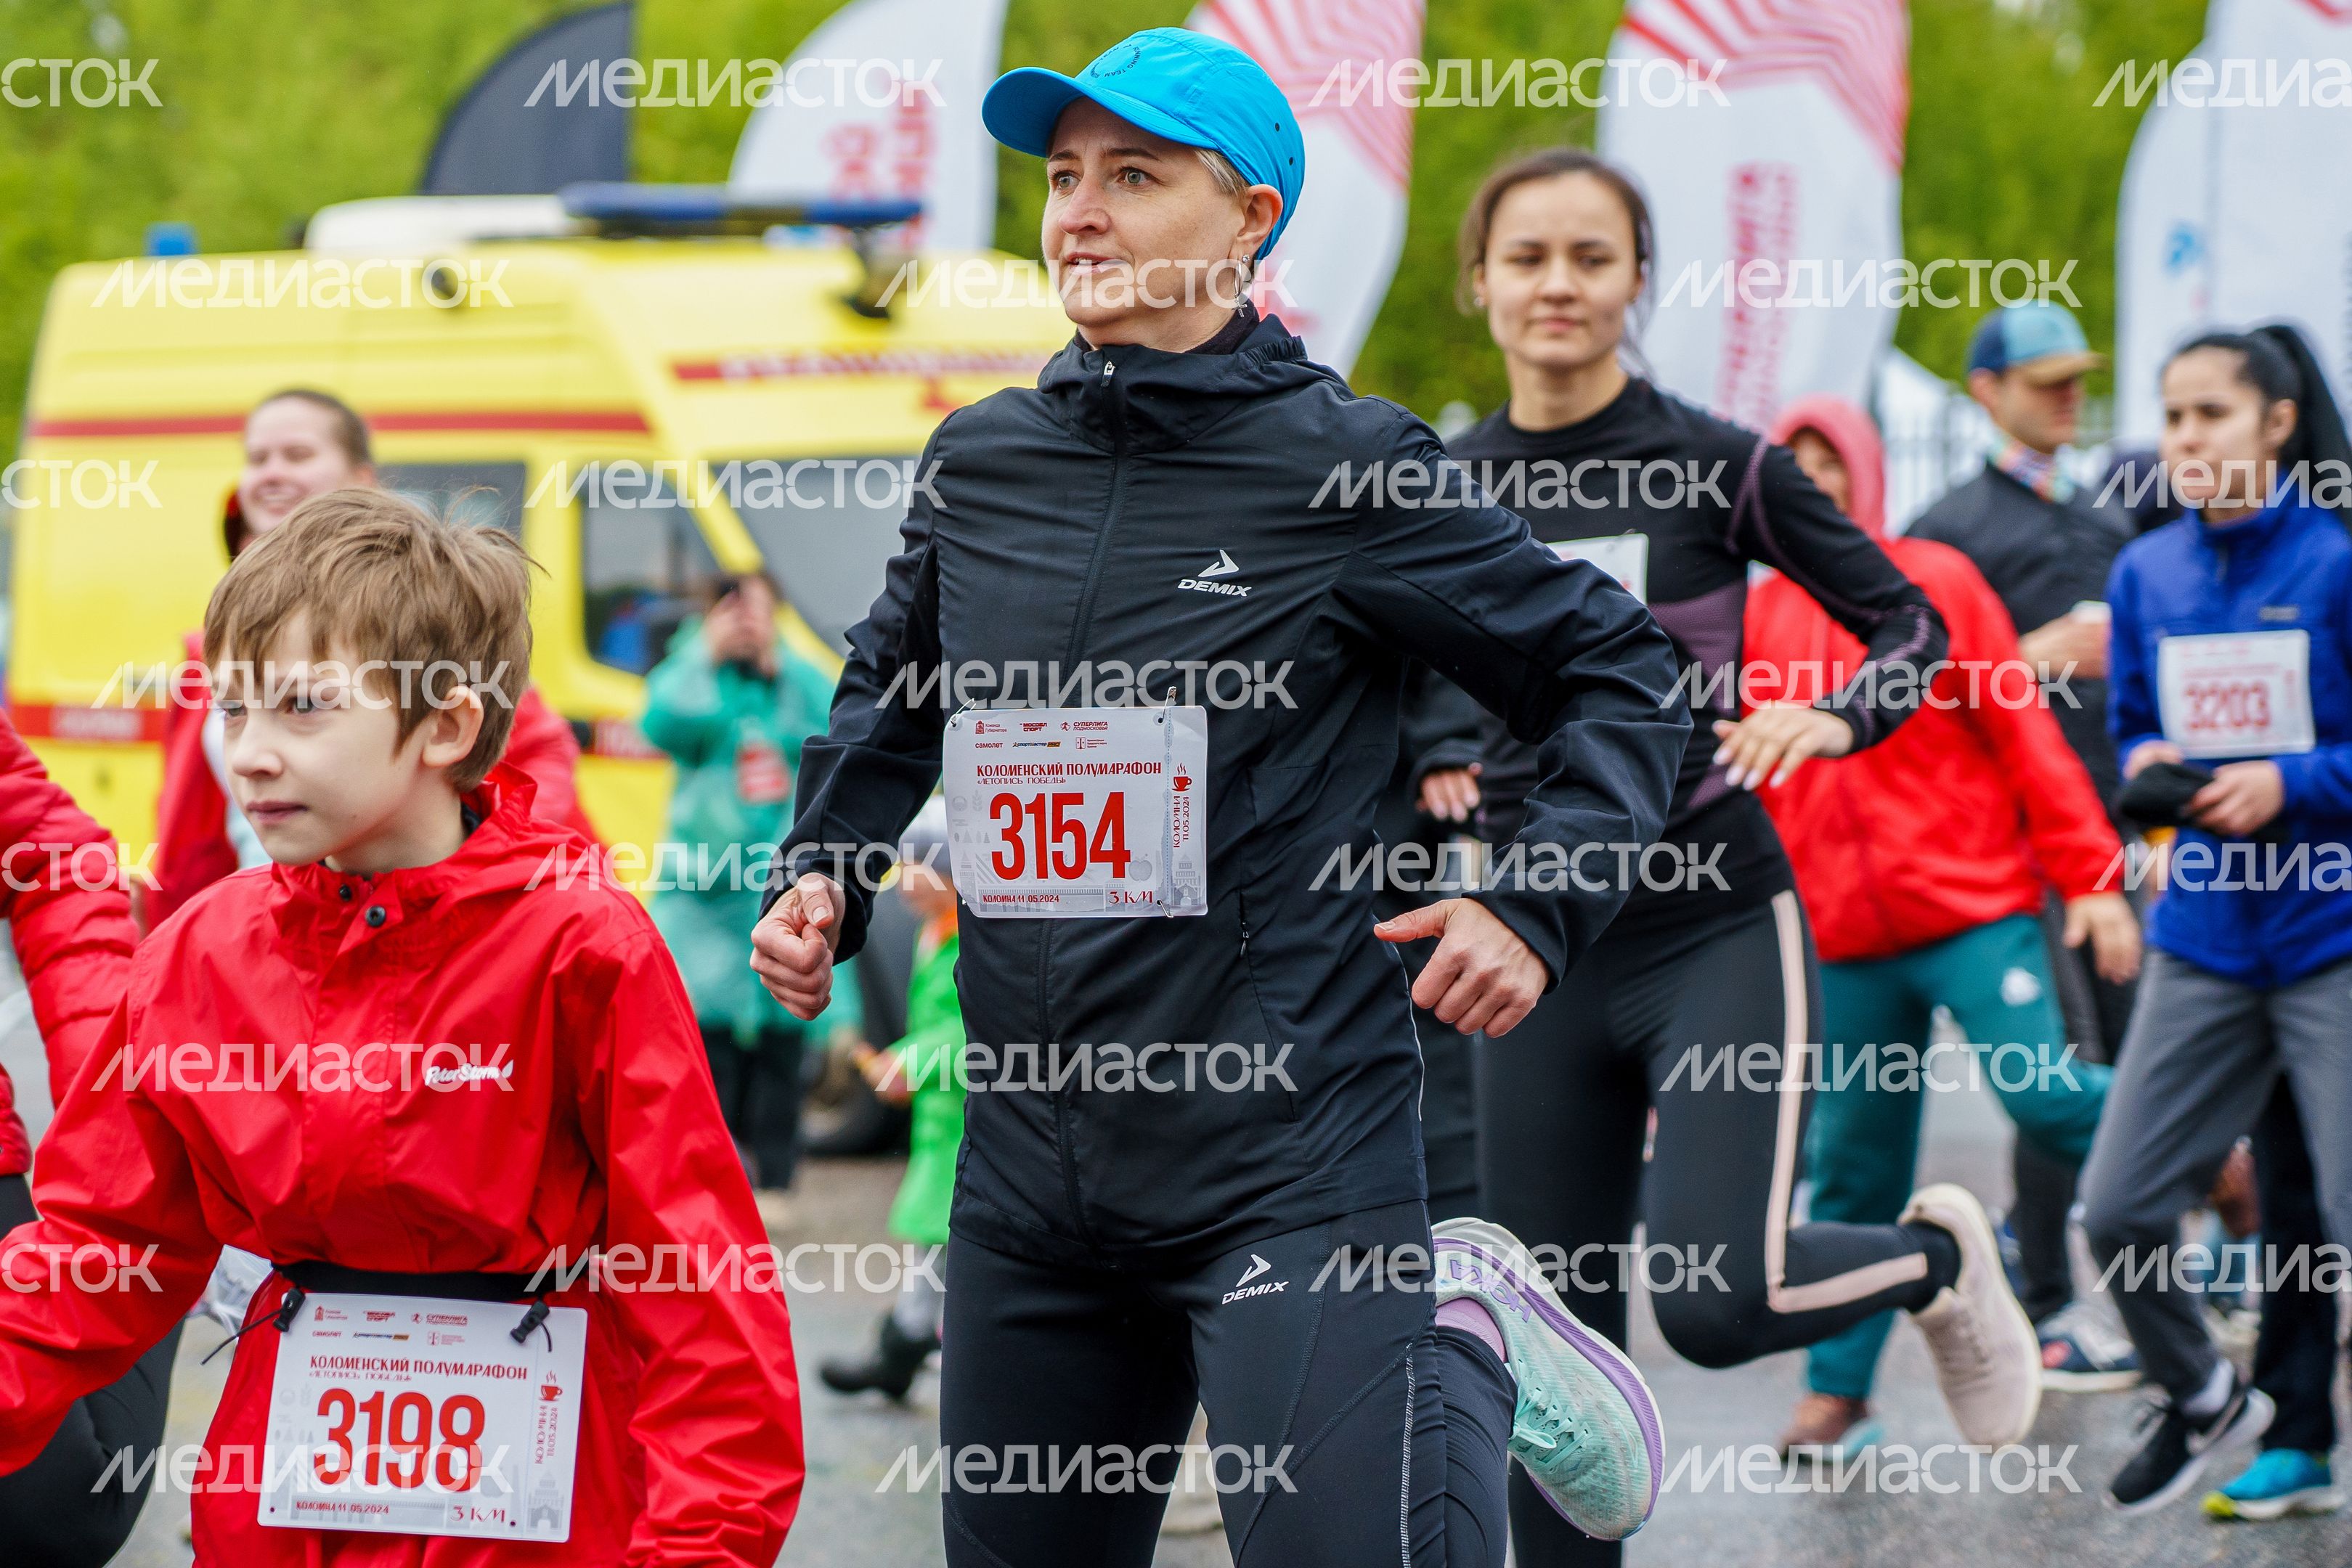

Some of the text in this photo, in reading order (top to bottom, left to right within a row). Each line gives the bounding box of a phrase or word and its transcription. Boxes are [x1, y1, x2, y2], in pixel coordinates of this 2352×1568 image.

[1178, 579, 1252, 597] DEMIX
[977, 761, 1161, 777] КОЛОМЕНСКИЙ ПОЛУМАРАФОН
[989, 791, 1131, 881] 3154
[982, 894, 1016, 904] КОЛОМНА
[1109, 891, 1153, 904] 3 КМ
[1221, 1281, 1289, 1304] DEMIX
[310, 1355, 410, 1372] КОЛОМЕНСКИЙ
[414, 1359, 528, 1380] ПОЛУМАРАФОН
[313, 1387, 485, 1493] 3198
[451, 1506, 505, 1524] 3 КМ
